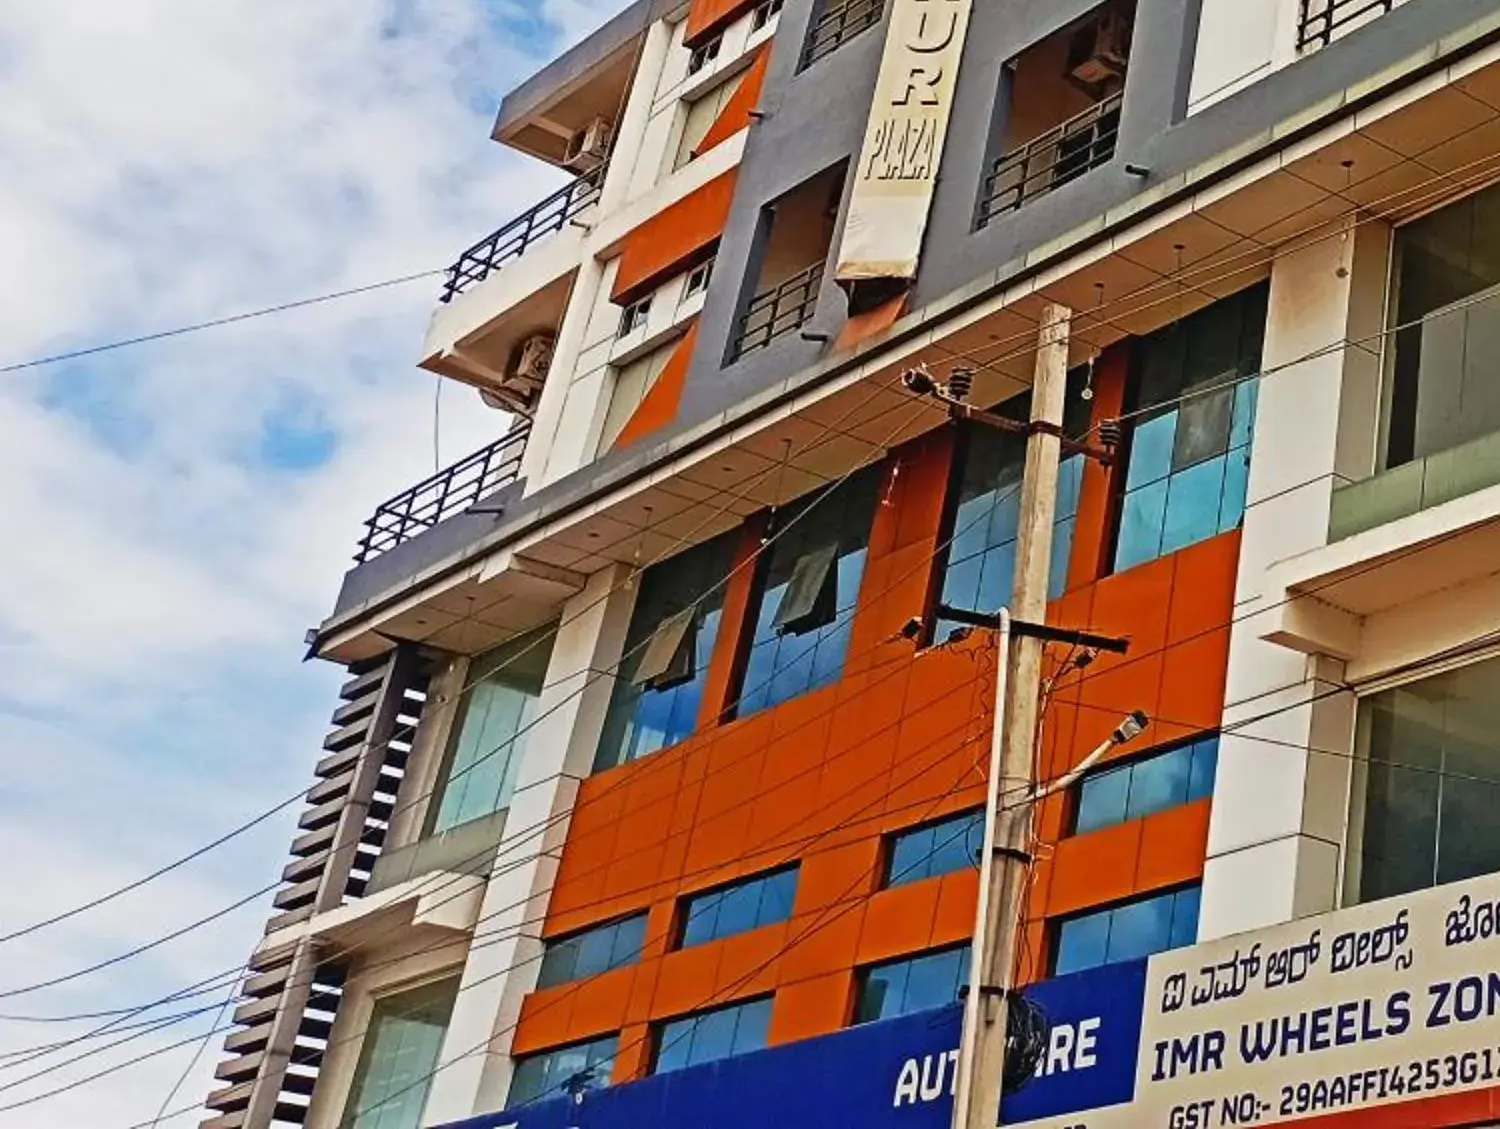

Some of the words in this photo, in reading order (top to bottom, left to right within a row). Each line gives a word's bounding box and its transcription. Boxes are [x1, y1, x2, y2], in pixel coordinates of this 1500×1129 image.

[864, 117, 938, 181] PLAZA
[1151, 1030, 1226, 1082] IMR
[1239, 991, 1412, 1064] WHEELS
[893, 1049, 962, 1107] AUT
[1168, 1100, 1215, 1129] GST
